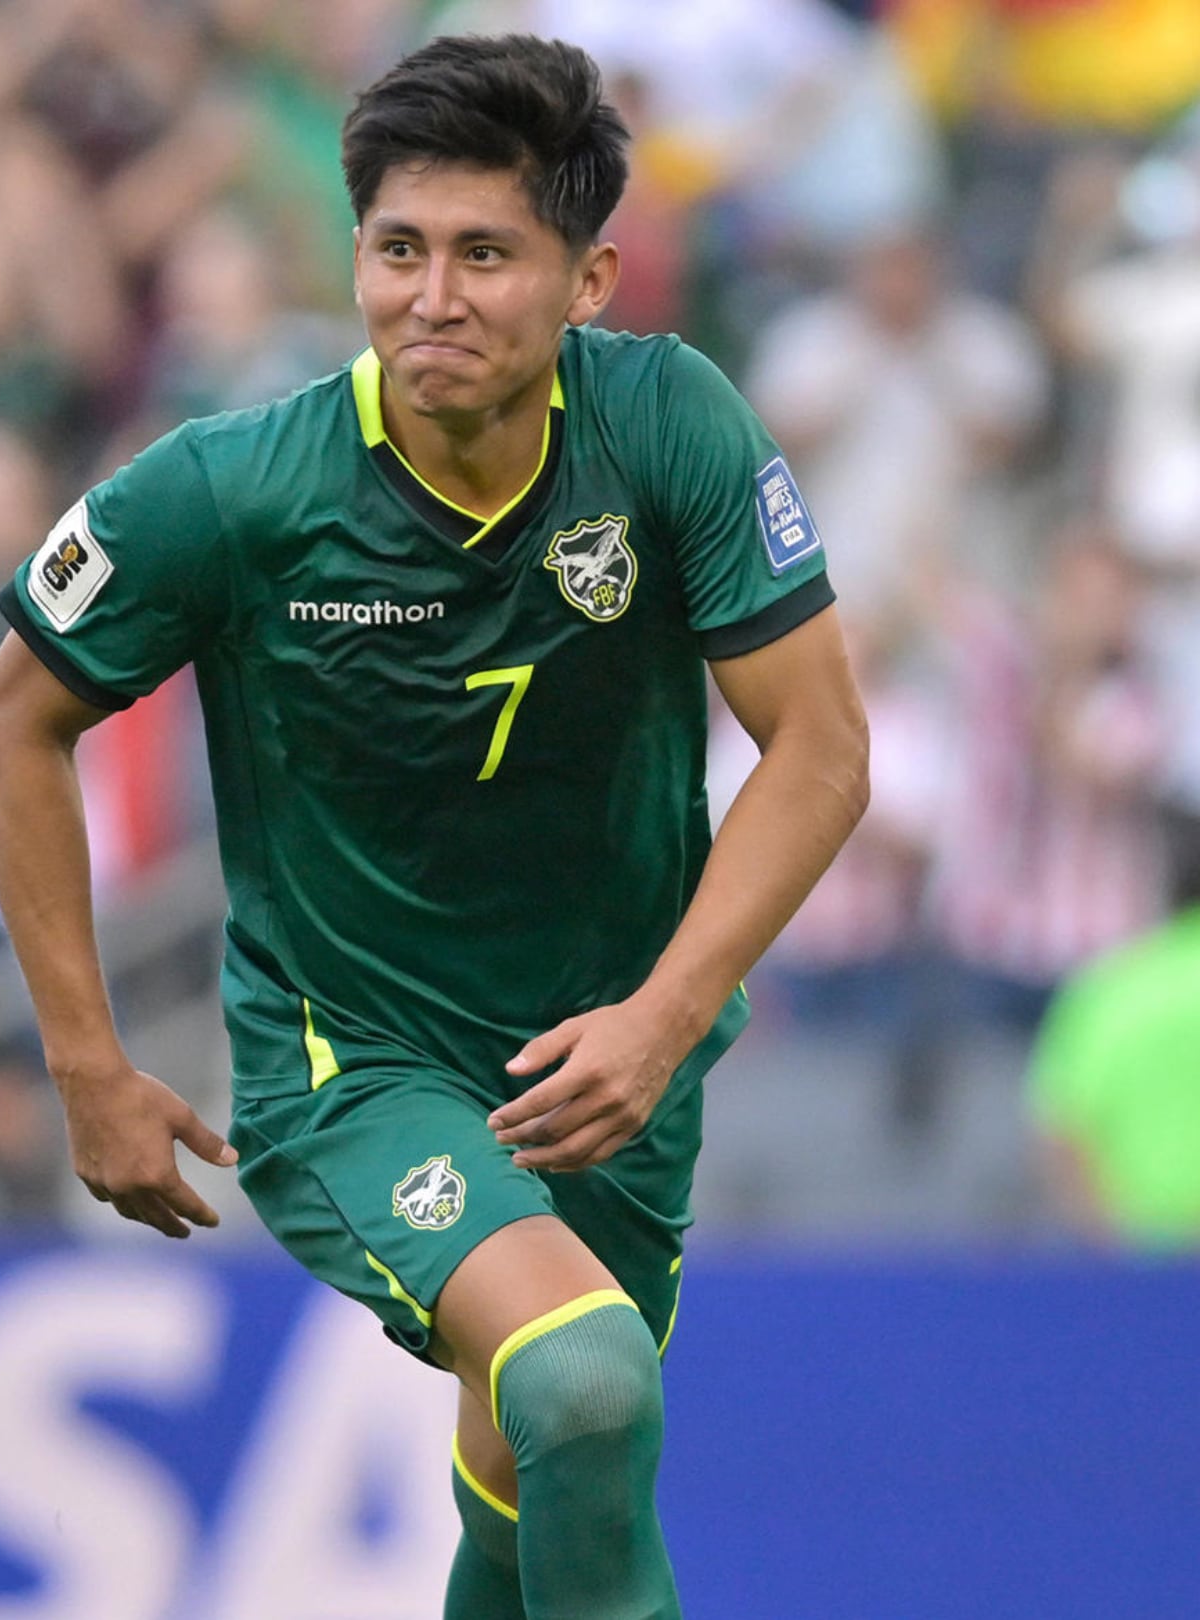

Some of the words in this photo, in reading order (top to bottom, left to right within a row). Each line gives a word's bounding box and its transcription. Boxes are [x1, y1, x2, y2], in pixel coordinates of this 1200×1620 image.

[592, 584, 616, 606] FBF
[289, 600, 445, 625] marathon
[464, 663, 536, 782] 7
